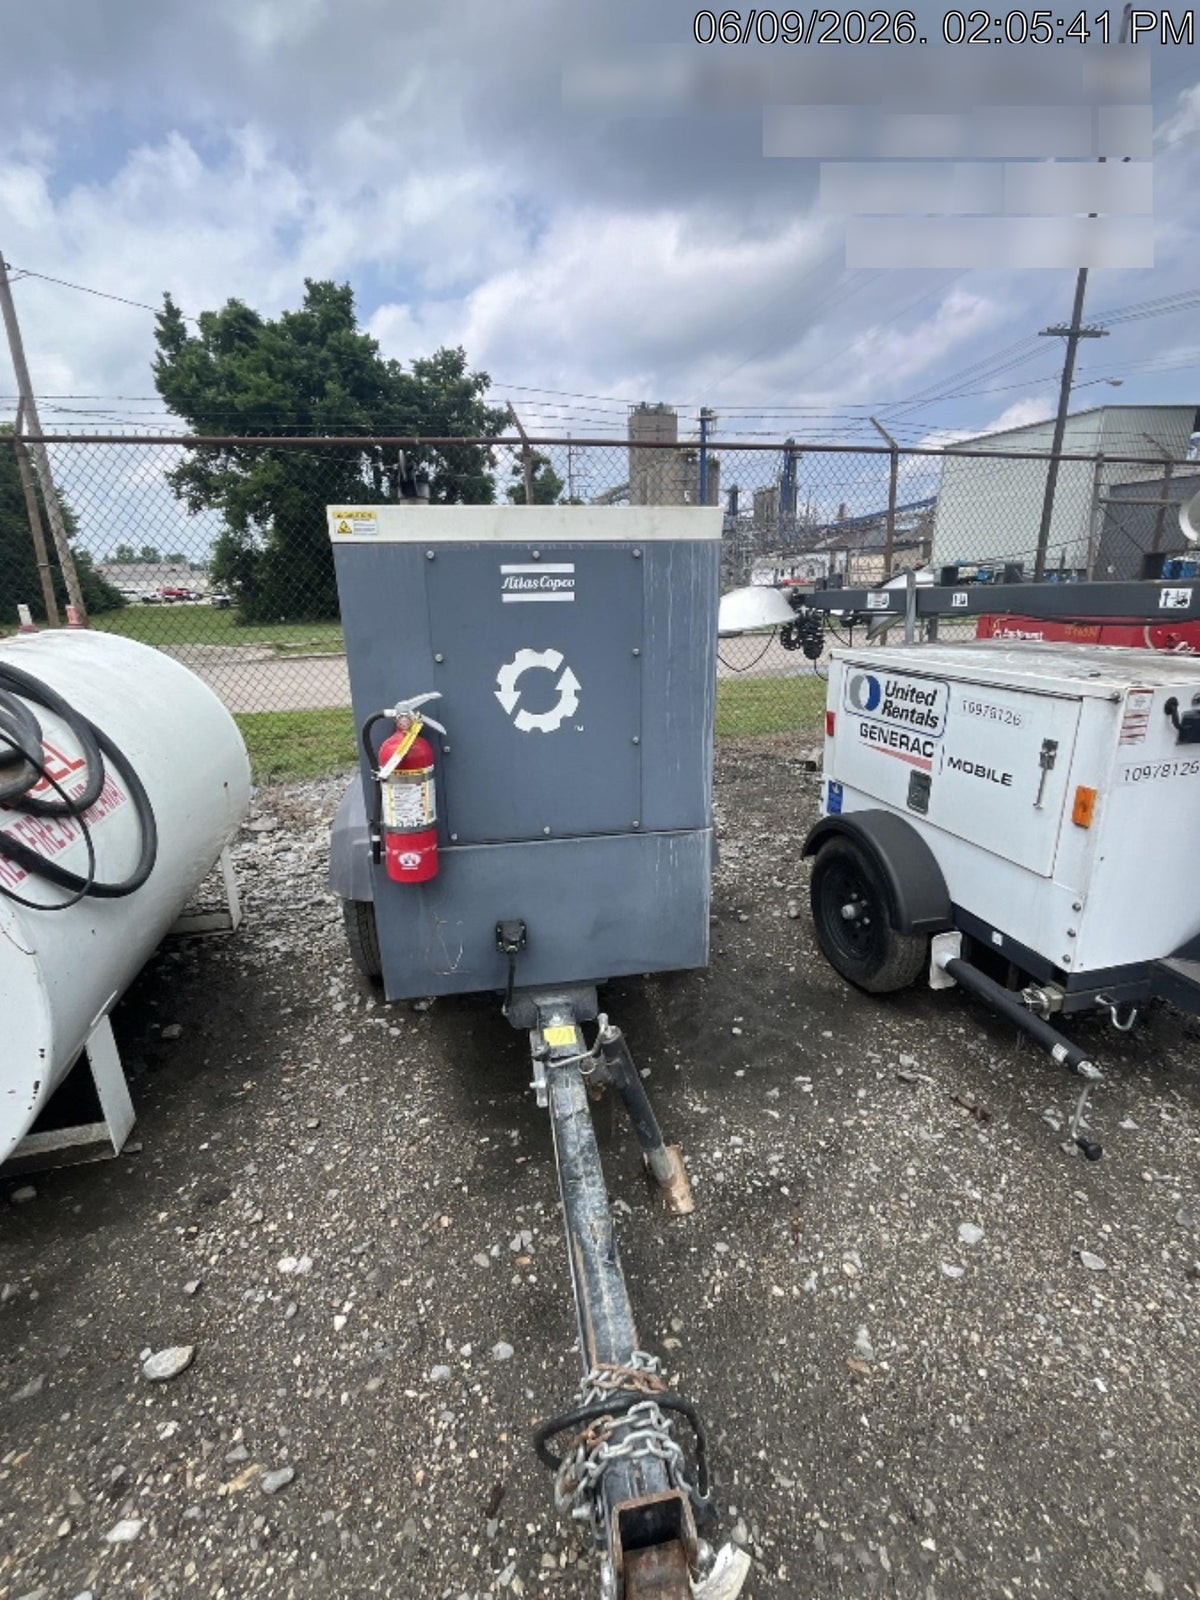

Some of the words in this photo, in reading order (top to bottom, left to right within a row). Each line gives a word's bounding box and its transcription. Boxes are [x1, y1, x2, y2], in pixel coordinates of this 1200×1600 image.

[501, 576, 539, 590] Atlas
[540, 575, 576, 591] Copco
[884, 681, 938, 706] United
[881, 700, 940, 729] Rentals
[962, 699, 1022, 726] 10978126
[860, 723, 934, 758] GENERAC
[947, 757, 1013, 786] MOBILE
[1124, 761, 1200, 781] 10978126
